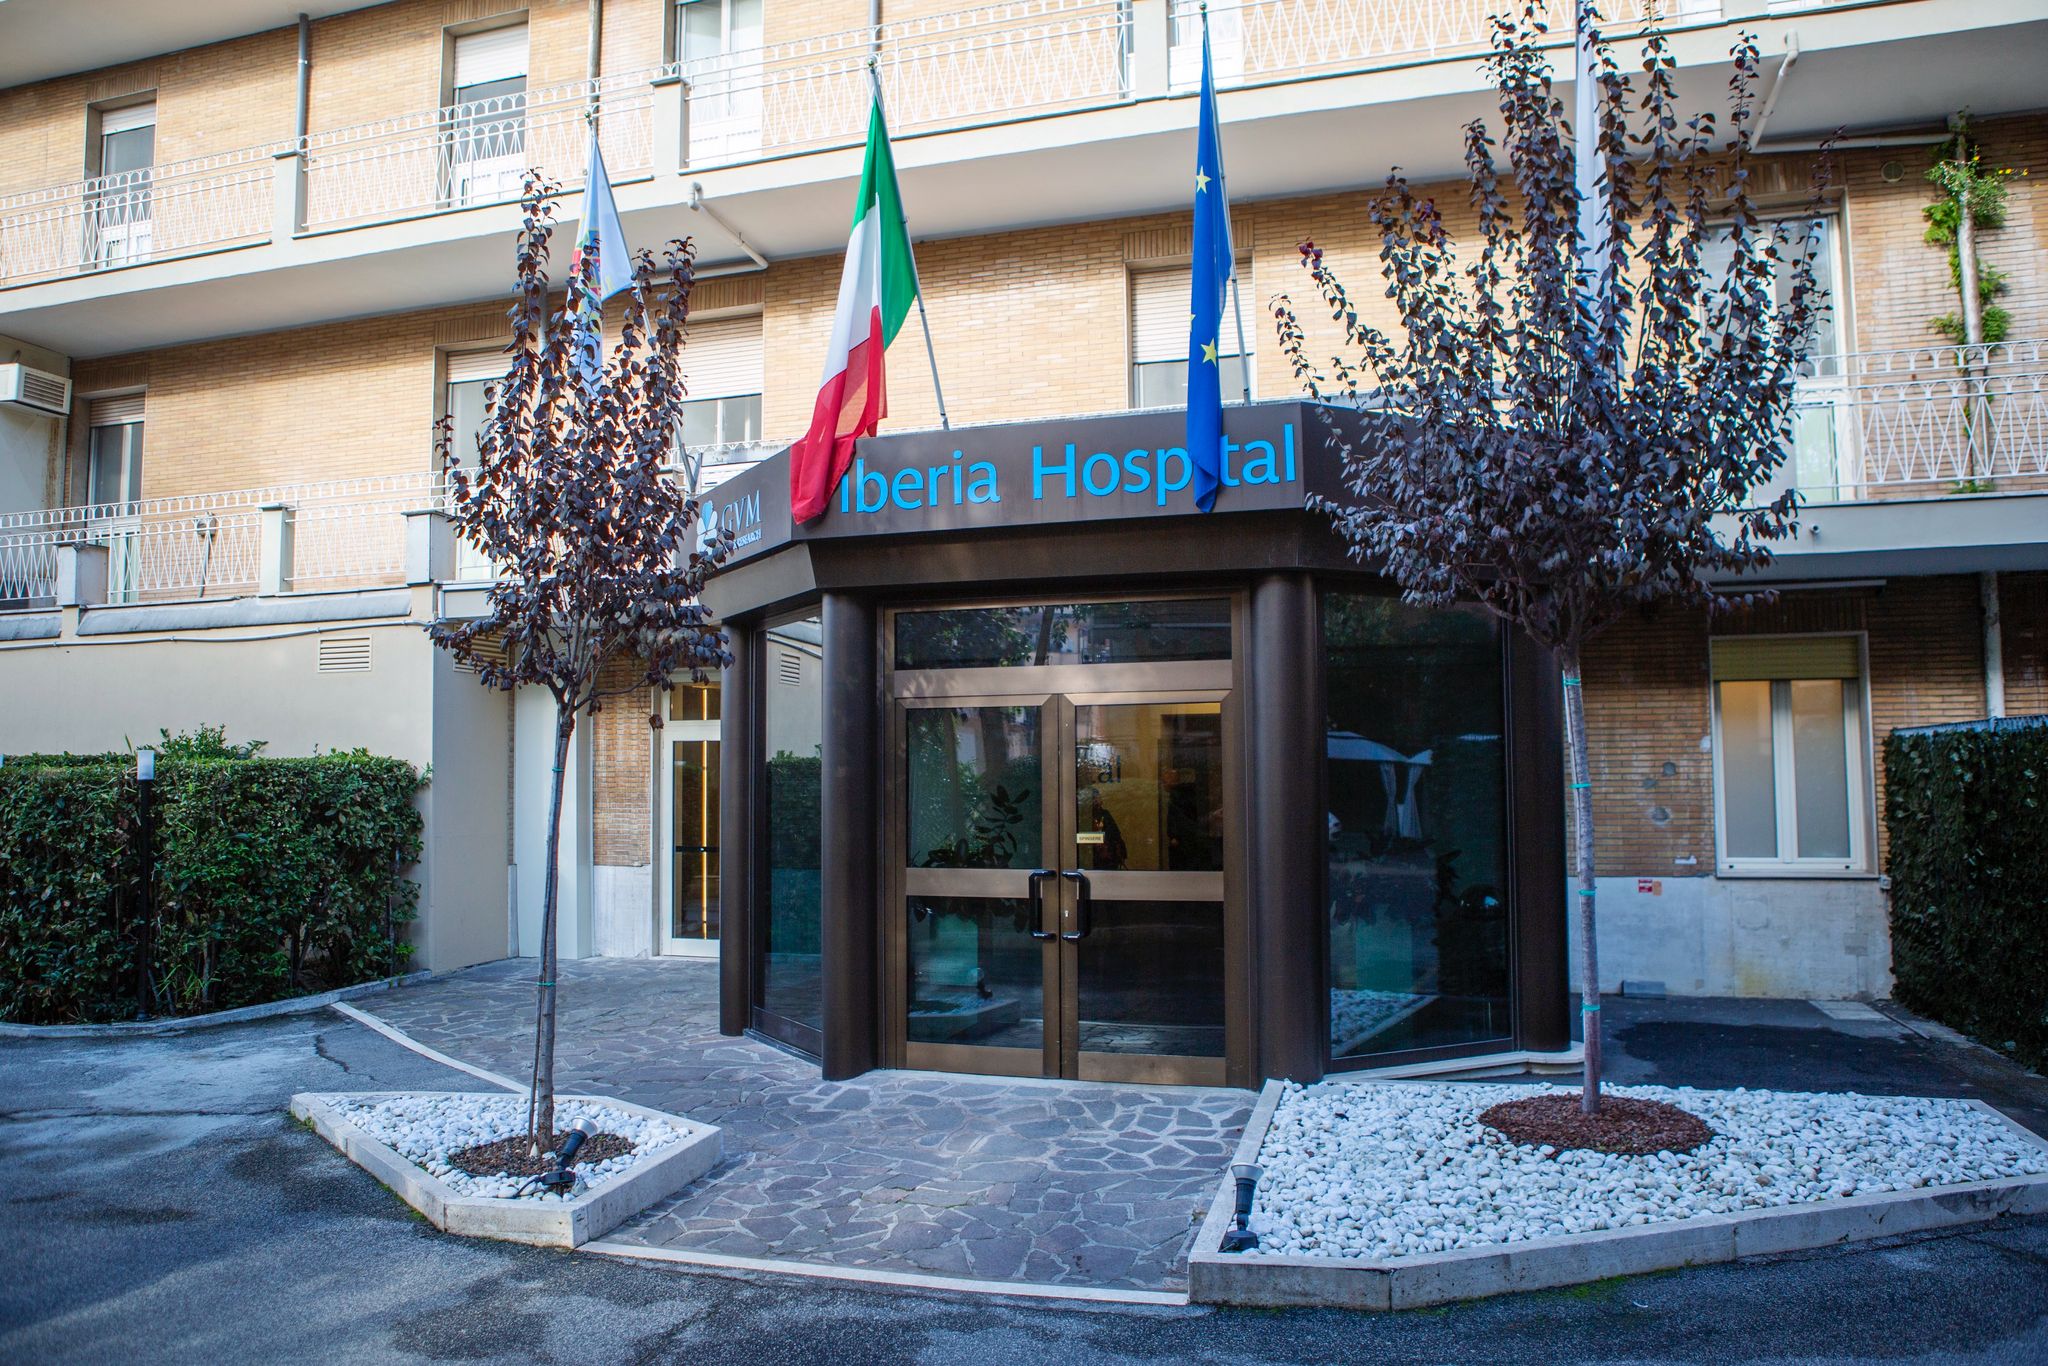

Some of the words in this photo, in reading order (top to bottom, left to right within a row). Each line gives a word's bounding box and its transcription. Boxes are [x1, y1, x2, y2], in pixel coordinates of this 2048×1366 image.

[841, 449, 1001, 514] Iberia
[1032, 423, 1296, 507] Hosptal
[721, 489, 761, 532] GVM
